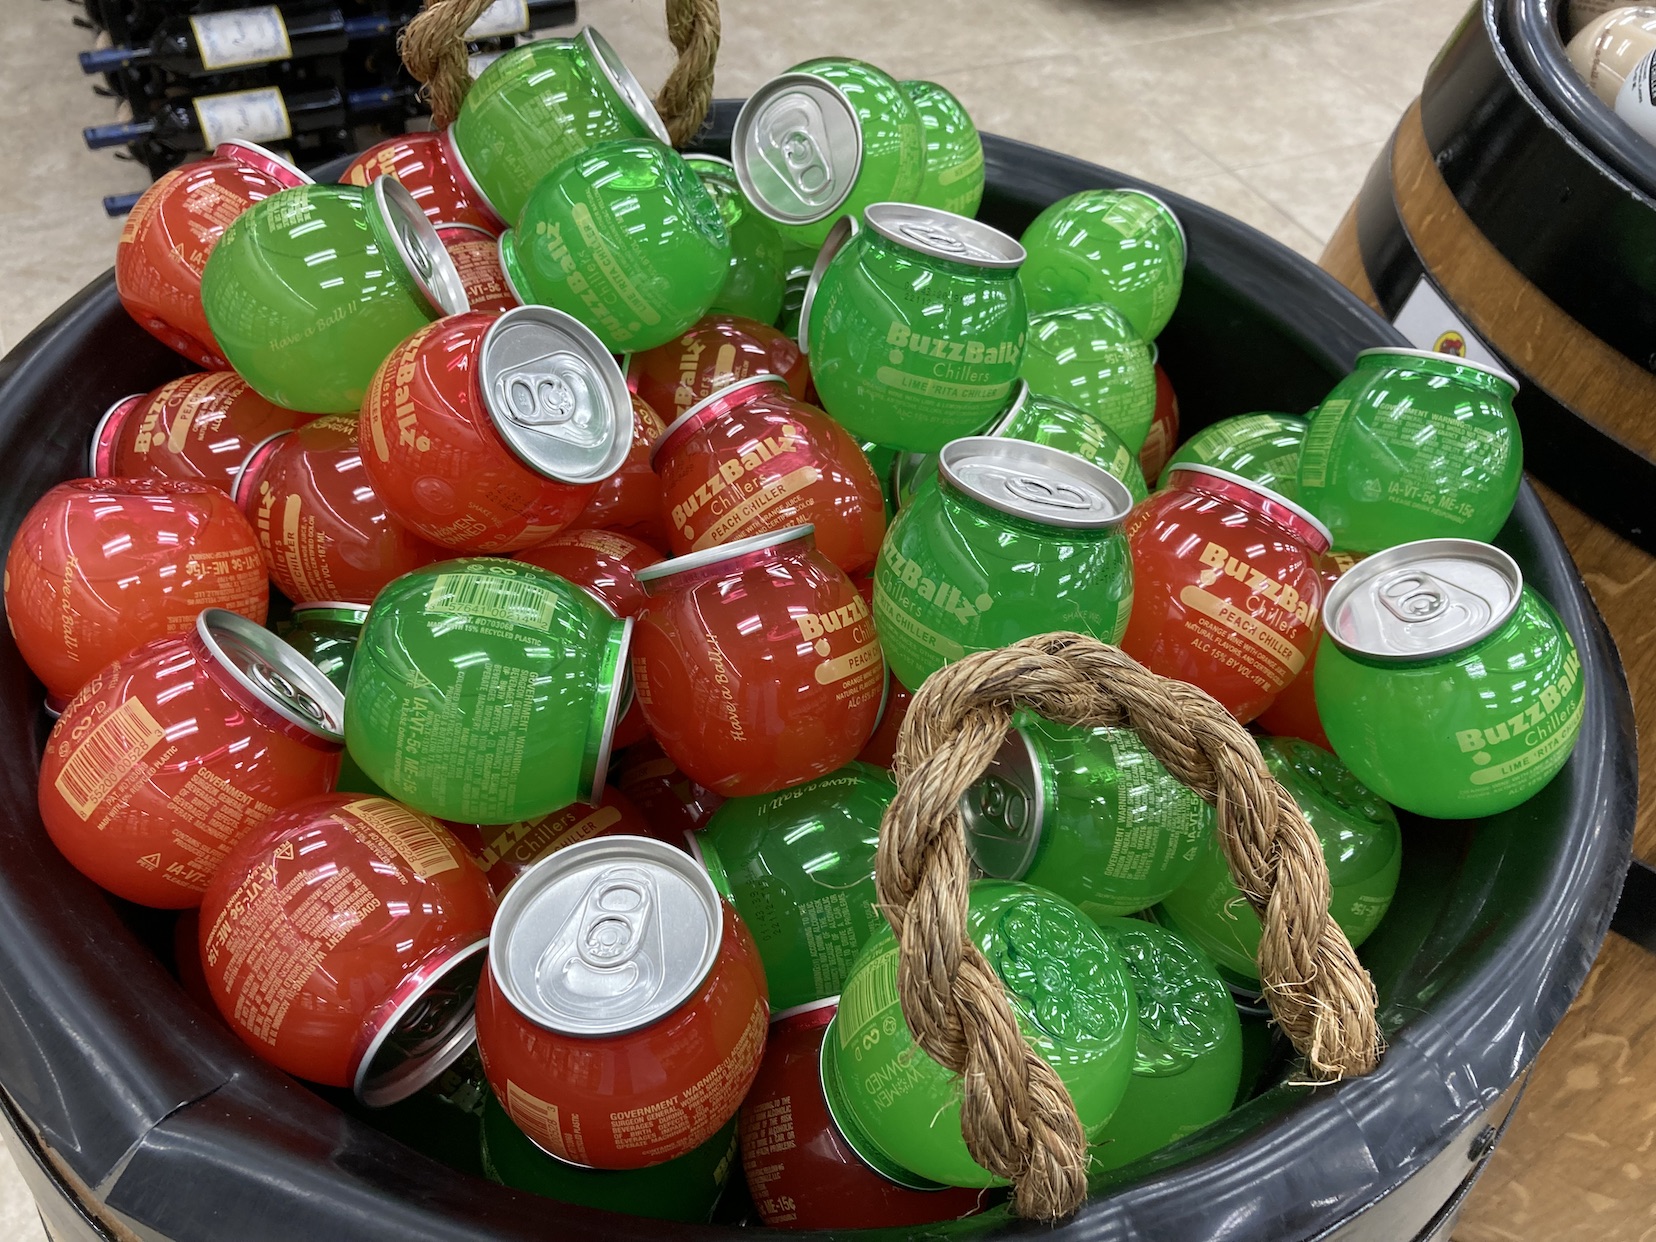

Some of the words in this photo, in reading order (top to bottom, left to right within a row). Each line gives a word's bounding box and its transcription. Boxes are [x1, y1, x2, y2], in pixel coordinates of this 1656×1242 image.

[269, 333, 302, 351] Have
[304, 327, 315, 338] a
[316, 307, 347, 331] Ball
[382, 347, 404, 408] Chillers
[396, 324, 437, 448] uzzBallz
[902, 377, 928, 391] LIME
[961, 388, 998, 397] CHILLER
[933, 363, 990, 382] Chillers
[671, 436, 797, 531] BuzzBallz
[710, 474, 768, 516] Chillers
[468, 501, 493, 517] SHAKE
[711, 512, 742, 541] PEACH
[743, 484, 787, 516] CHILLER
[62, 554, 79, 599] Have
[881, 569, 922, 618] Chillers
[882, 543, 979, 626] zzBallz
[1199, 541, 1319, 631] BuzzBall
[62, 598, 71, 614] a
[448, 602, 486, 615] 57641
[1246, 595, 1298, 640] Chillers
[61, 614, 78, 650] Ball
[480, 625, 515, 640] RECYCLED
[514, 633, 542, 647] PLASTIC
[895, 611, 938, 647] CHILLER
[1184, 621, 1215, 641] NATURAL
[1241, 653, 1254, 666] AND
[1198, 617, 1228, 638] ORANGE
[1227, 632, 1244, 647] WINE
[1243, 641, 1257, 656] WITH
[1218, 607, 1258, 636] PEACH
[1258, 631, 1293, 661] CHILLER
[707, 646, 729, 685] Ball
[848, 650, 873, 670] PEACH
[1190, 638, 1211, 653] ALC
[1210, 648, 1227, 663] 15%
[1225, 658, 1240, 670] BY
[1237, 666, 1253, 679] VOL
[721, 685, 733, 700] a
[835, 687, 860, 701] NATURAL
[842, 674, 864, 689] ORANGE
[726, 701, 748, 742] Have
[847, 696, 861, 710] ALC
[1525, 700, 1576, 747] Chillers
[90, 772, 118, 805] 55200
[116, 740, 150, 774] 00528
[151, 745, 179, 769] PLASTIC
[1501, 756, 1530, 775] LIME
[197, 766, 254, 806] GOVERNMENT
[769, 788, 804, 810] Ball
[818, 776, 858, 788] Have
[514, 812, 577, 862] Chillers
[1103, 826, 1126, 877] GOVERNMENT
[610, 1095, 679, 1121] GOVERNMENT
[611, 1117, 644, 1128] SURGEON
[612, 1121, 654, 1134] BEVERAGES
[613, 1132, 623, 1140] OF
[630, 1127, 652, 1138] BIRTH
[614, 1133, 657, 1145] BEVERAGES
